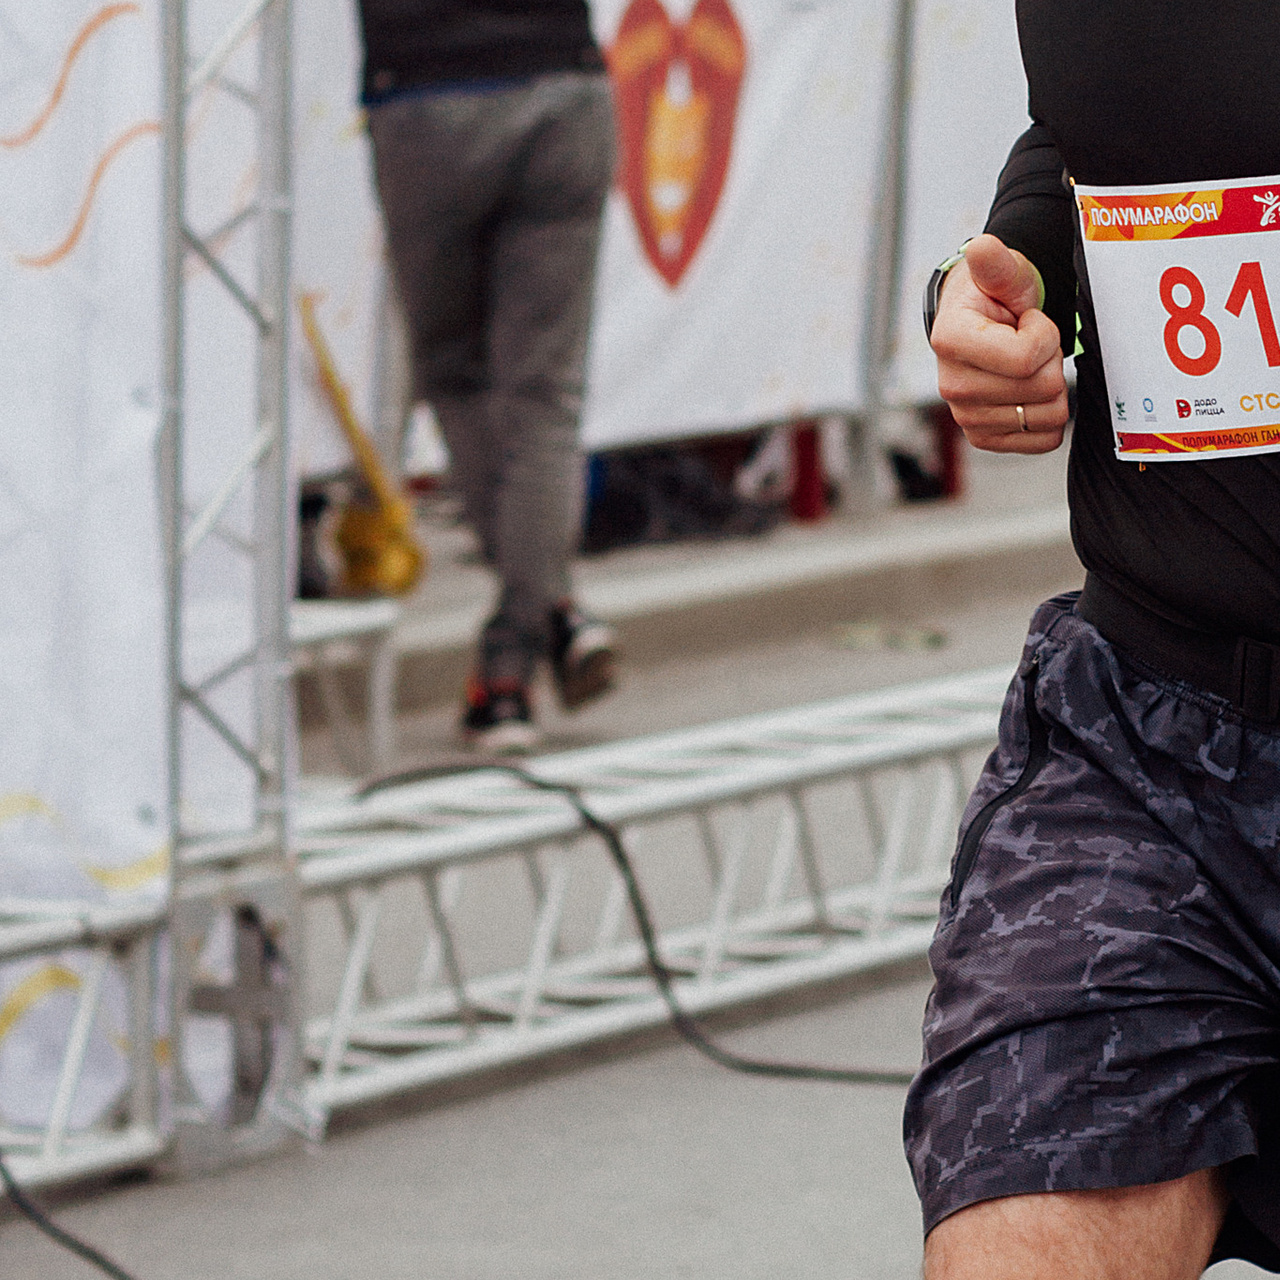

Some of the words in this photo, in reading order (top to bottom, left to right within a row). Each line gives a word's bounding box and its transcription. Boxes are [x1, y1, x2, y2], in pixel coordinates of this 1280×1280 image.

[1091, 202, 1219, 227] ПОЛУМАРАФОН
[1195, 408, 1226, 416] ПИЦЦА
[1182, 432, 1259, 448] ПОЛУМАРАФОН
